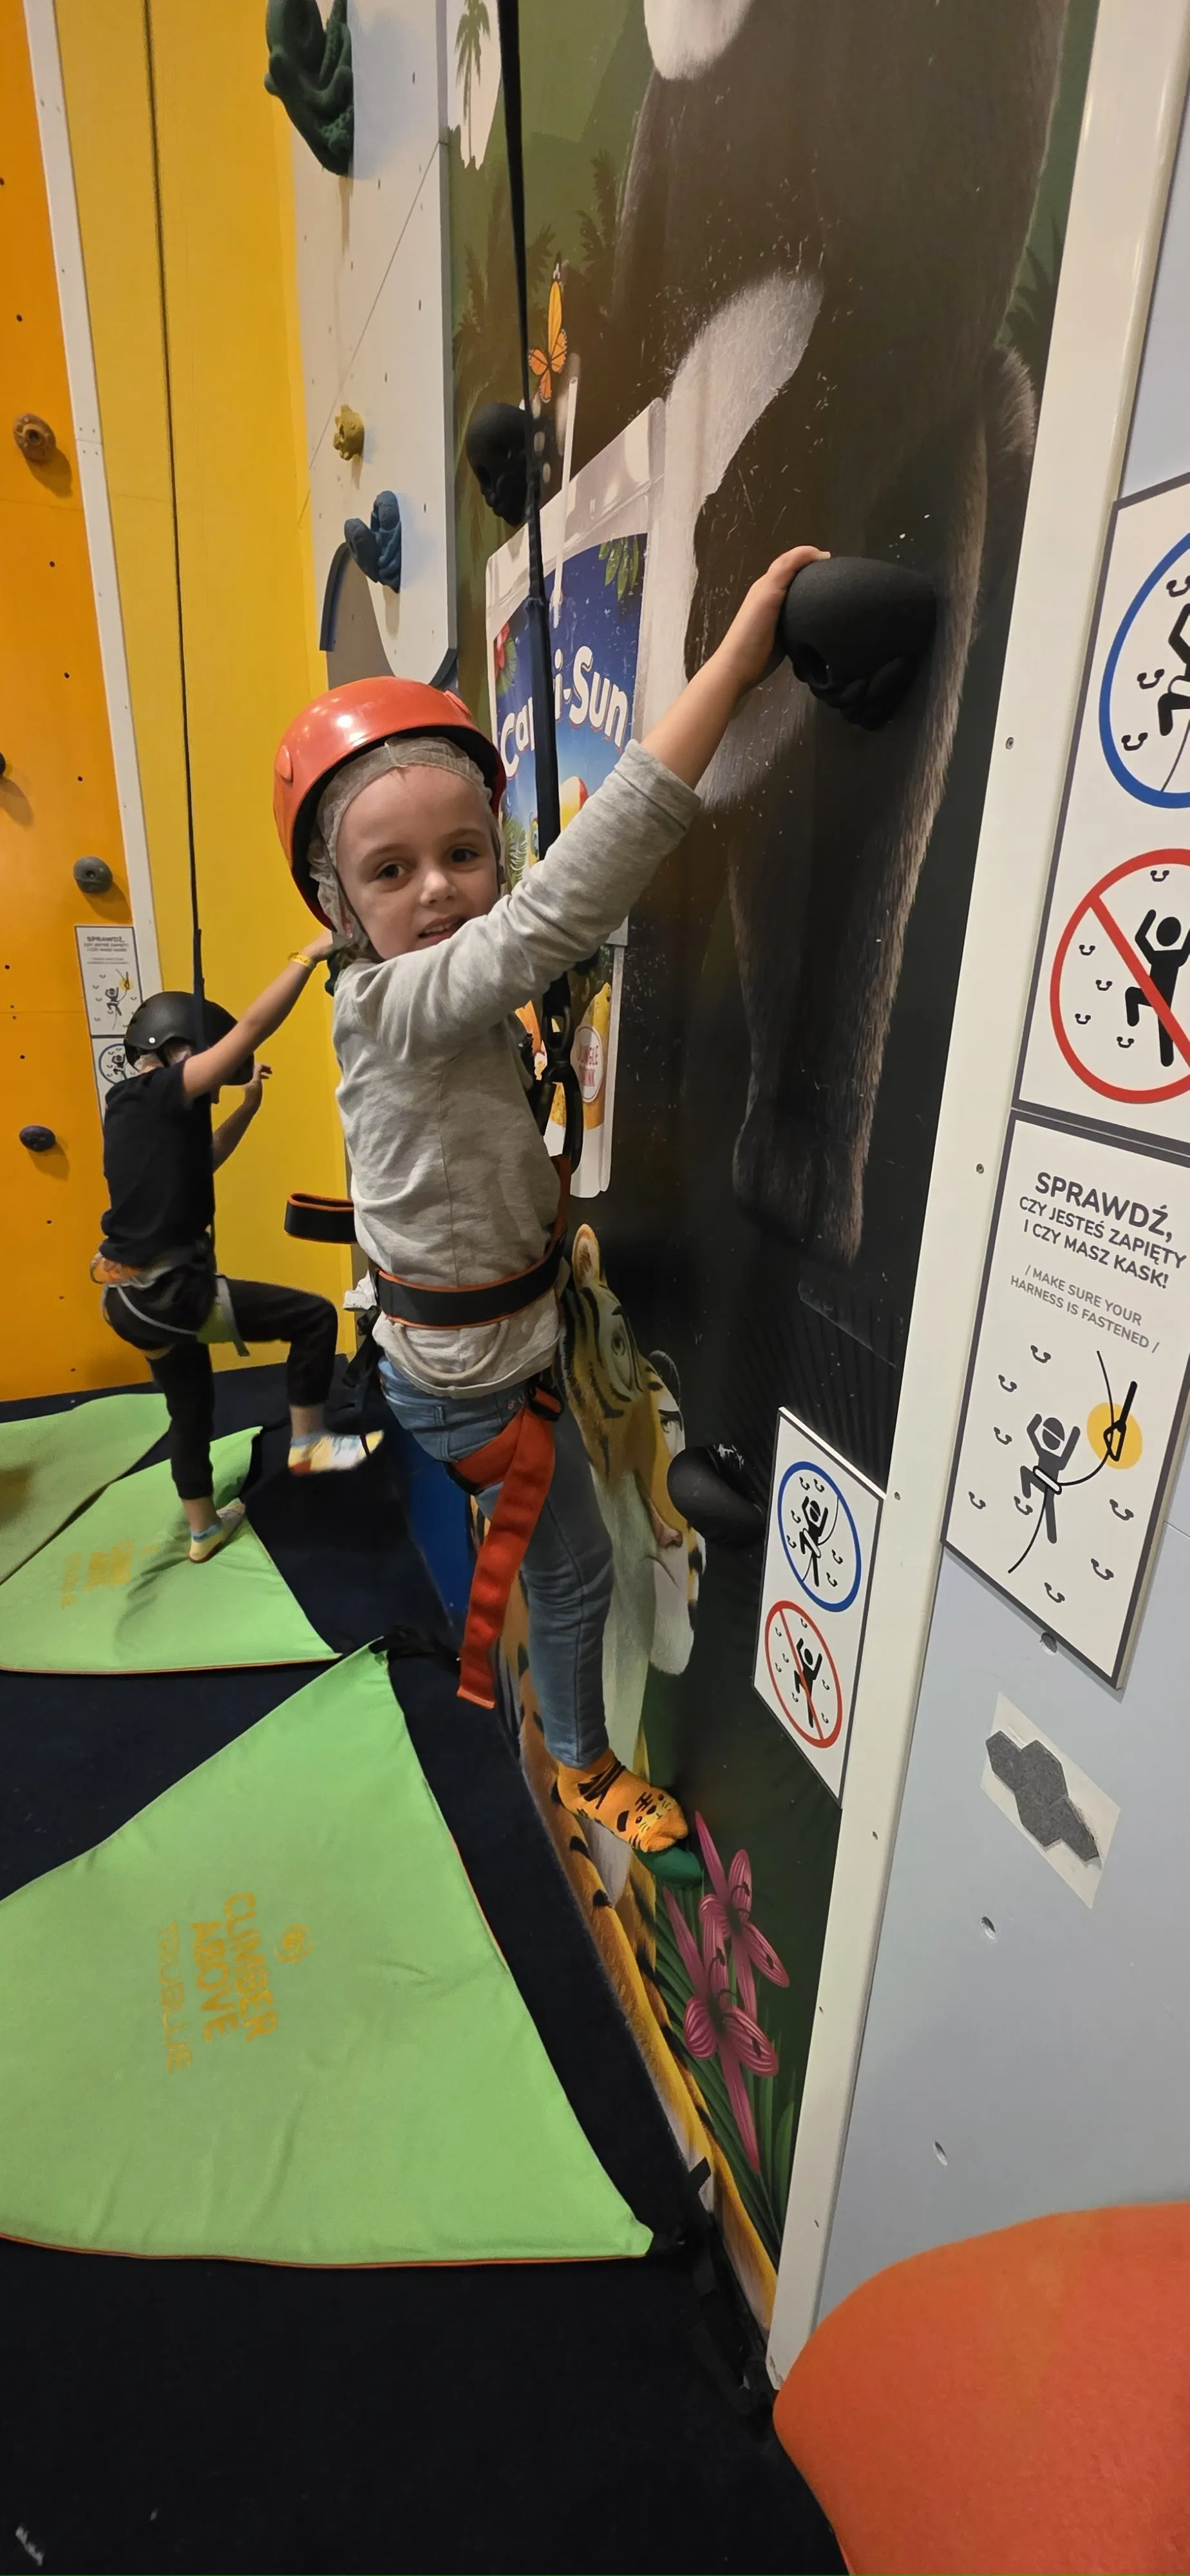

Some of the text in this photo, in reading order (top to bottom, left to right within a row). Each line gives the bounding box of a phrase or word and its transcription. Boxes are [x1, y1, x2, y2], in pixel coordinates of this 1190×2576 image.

[500, 645, 628, 779] Cai-Sun
[1019, 1196, 1187, 1269] CZY JESTEŚ ZAPIĘTY
[1035, 1171, 1173, 1243] SPRAWDŹ,
[1023, 1218, 1169, 1289] I CZY MASZ KASK!
[1010, 1274, 1064, 1309] HARNESS
[1066, 1301, 1079, 1316] IS
[1081, 1308, 1149, 1349] FASTENED
[1032, 1267, 1066, 1292] MAKE
[1067, 1284, 1102, 1308] SURE
[1104, 1299, 1142, 1327] YOUR
[191, 1921, 238, 2042] ABOVE
[224, 1892, 278, 2043] CLIMBER
